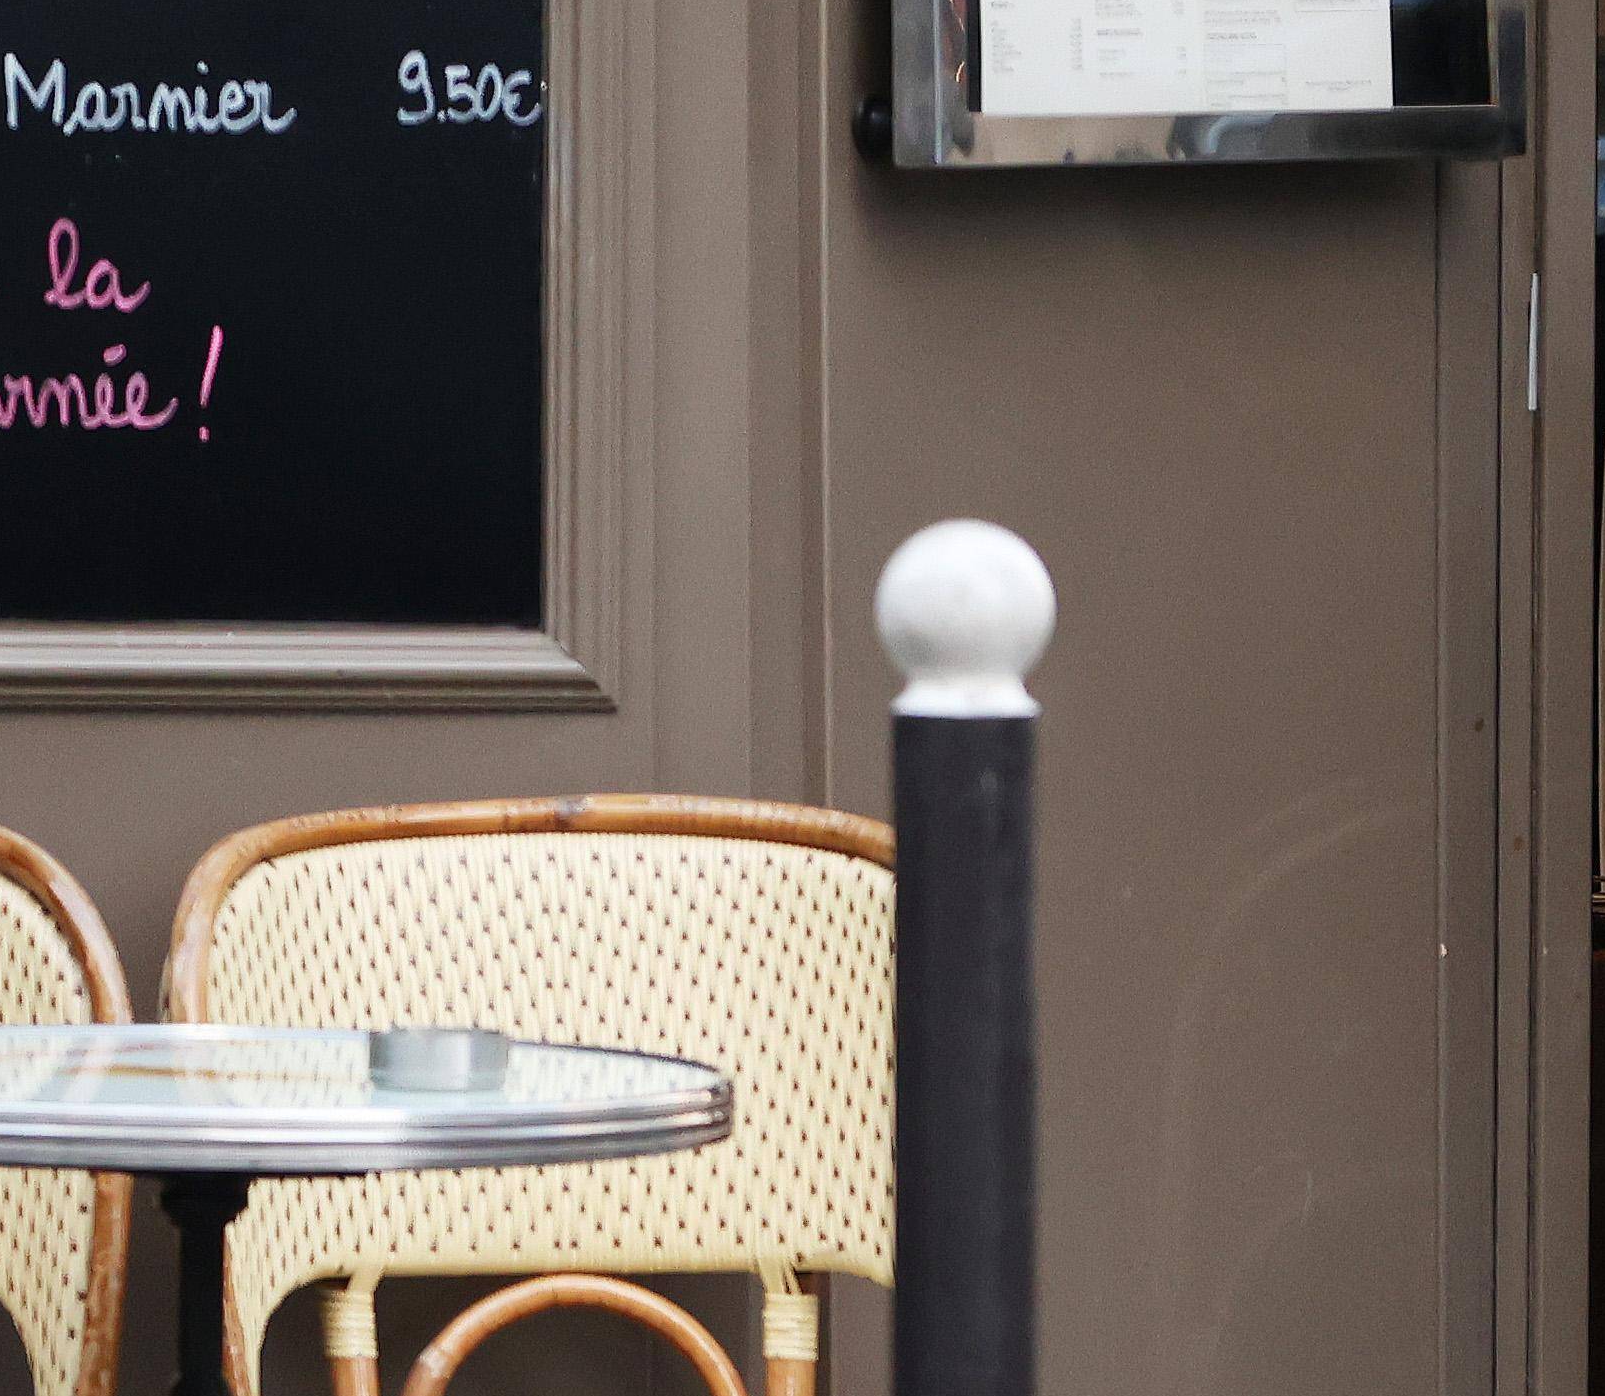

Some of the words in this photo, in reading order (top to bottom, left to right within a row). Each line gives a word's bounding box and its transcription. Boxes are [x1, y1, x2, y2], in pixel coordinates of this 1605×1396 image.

[4, 53, 296, 135] Marnier
[398, 50, 543, 125] 9.50€
[45, 218, 149, 312] la
